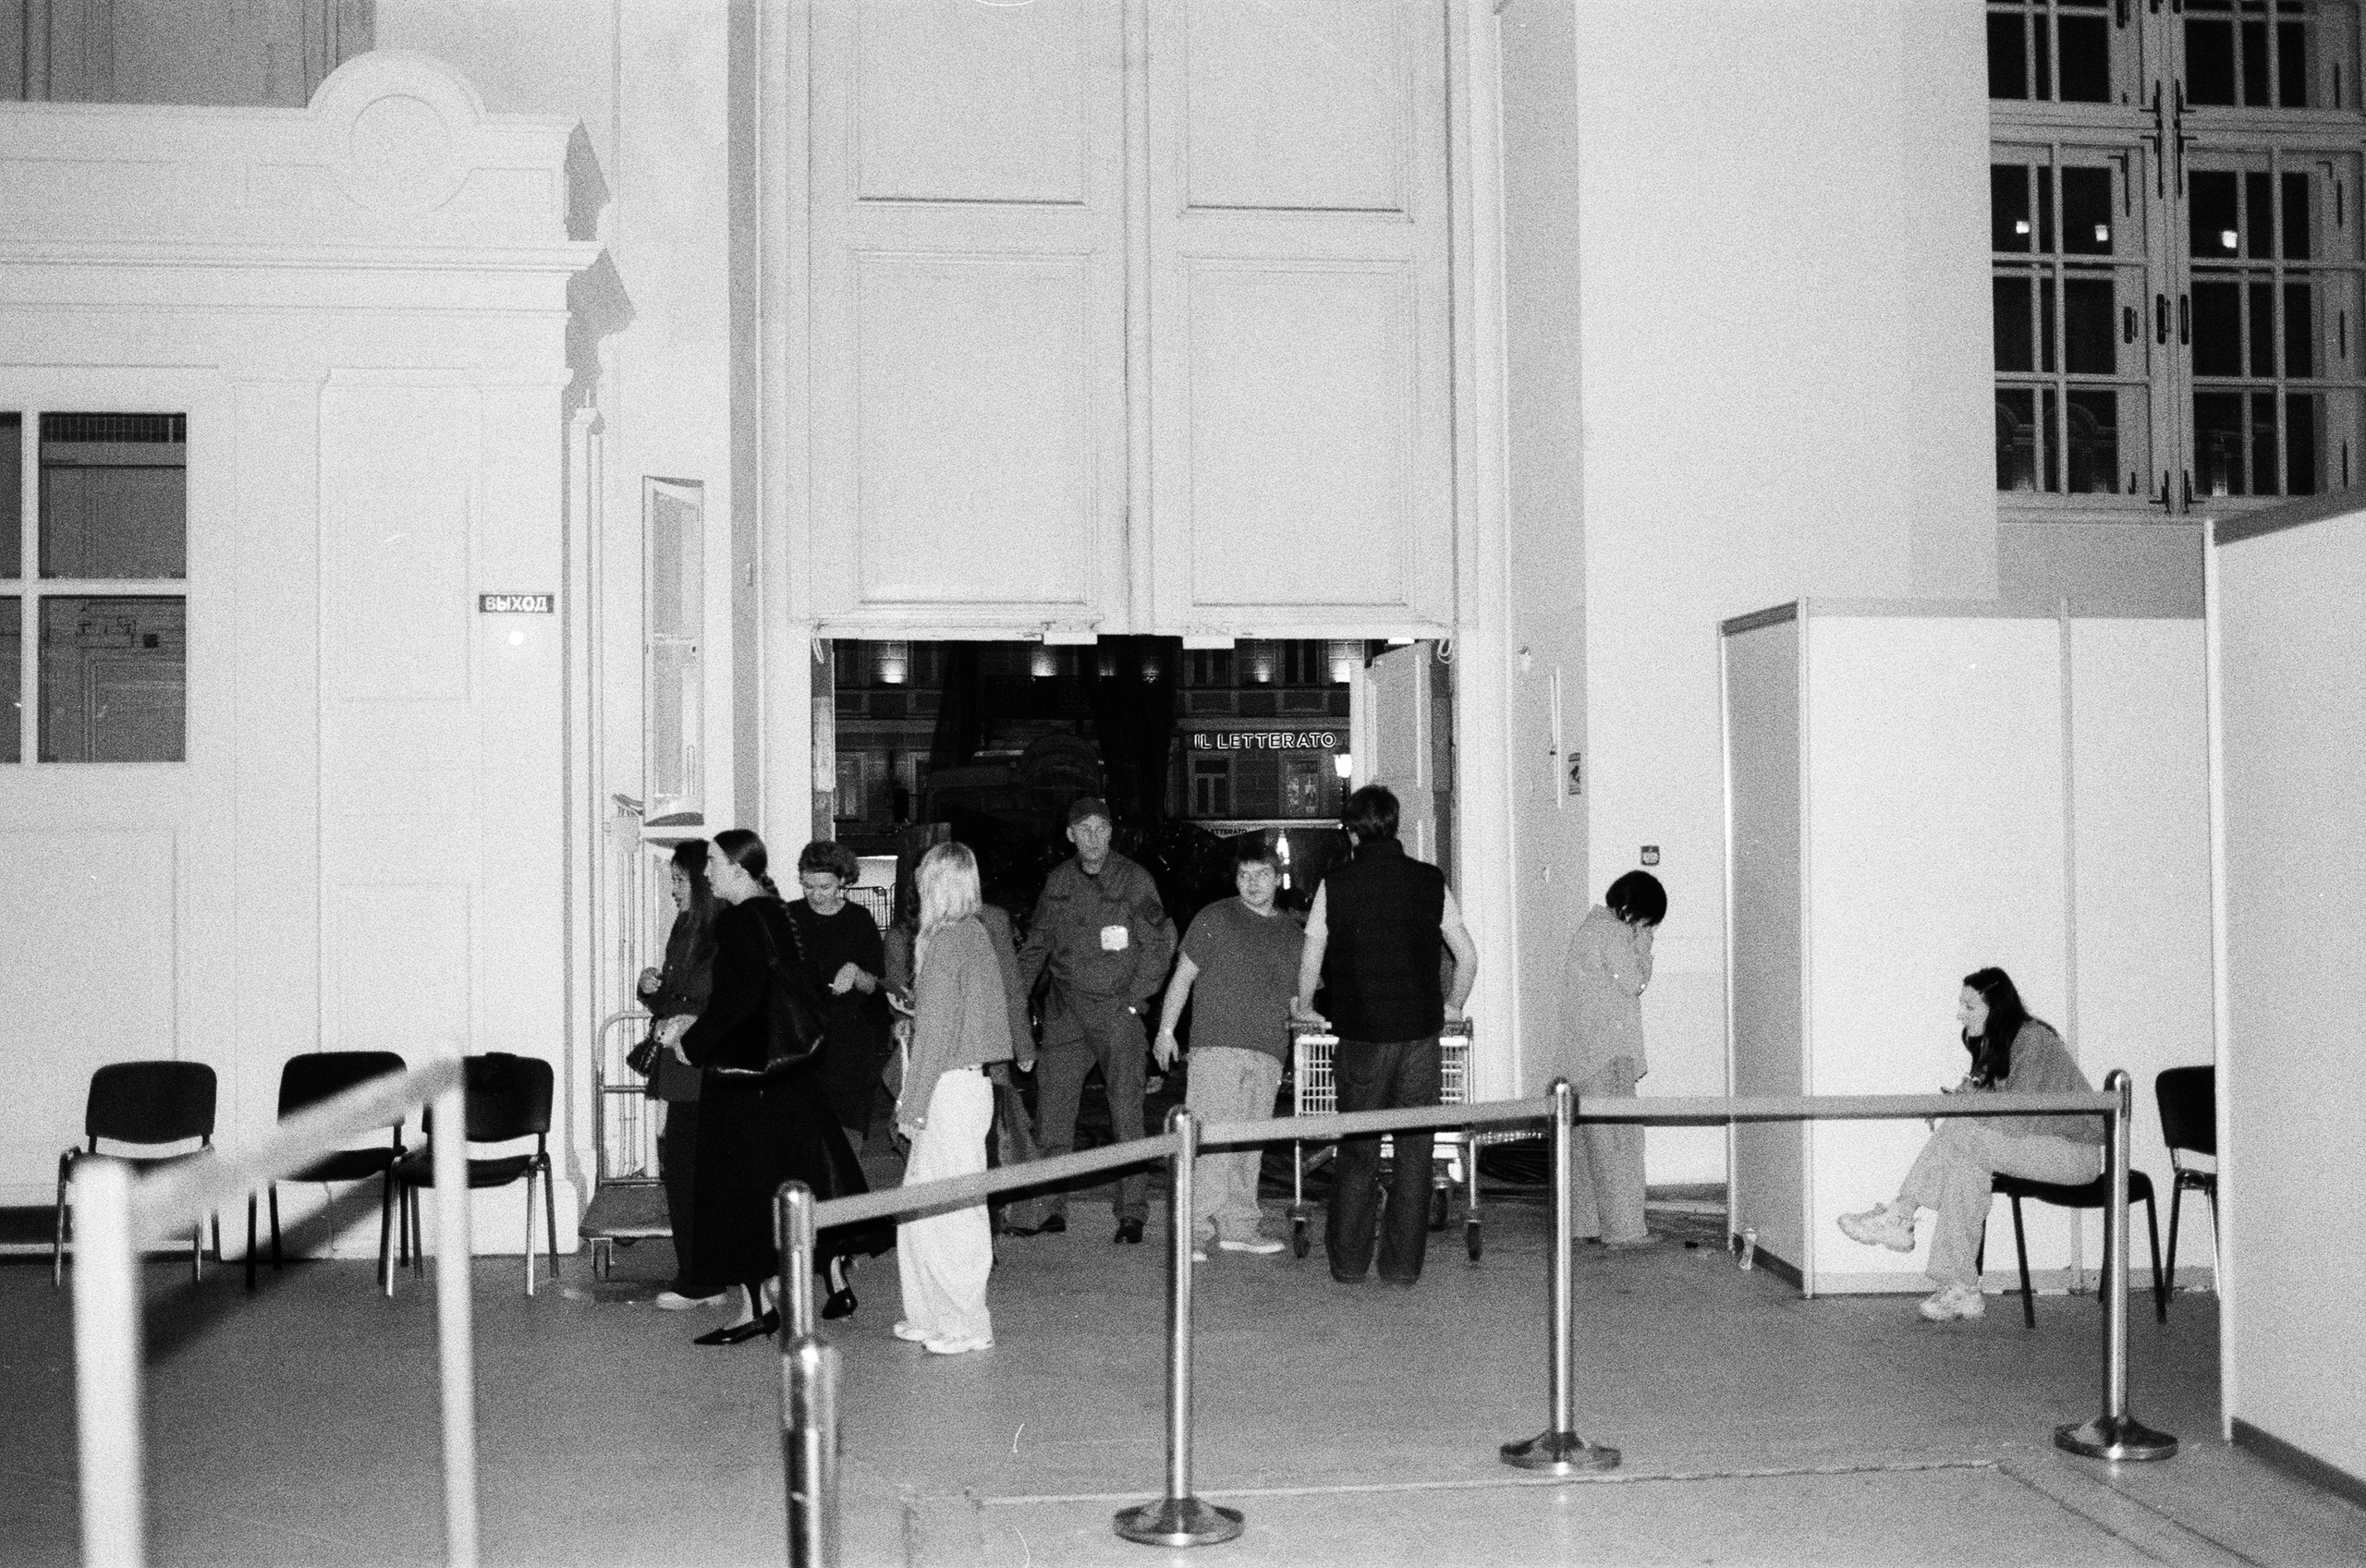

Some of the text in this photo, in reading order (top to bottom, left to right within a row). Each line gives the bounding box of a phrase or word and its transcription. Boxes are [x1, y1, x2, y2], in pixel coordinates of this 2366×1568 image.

[484, 595, 548, 612] ВЫХОД
[1194, 732, 1336, 749] IL LETTERATO
